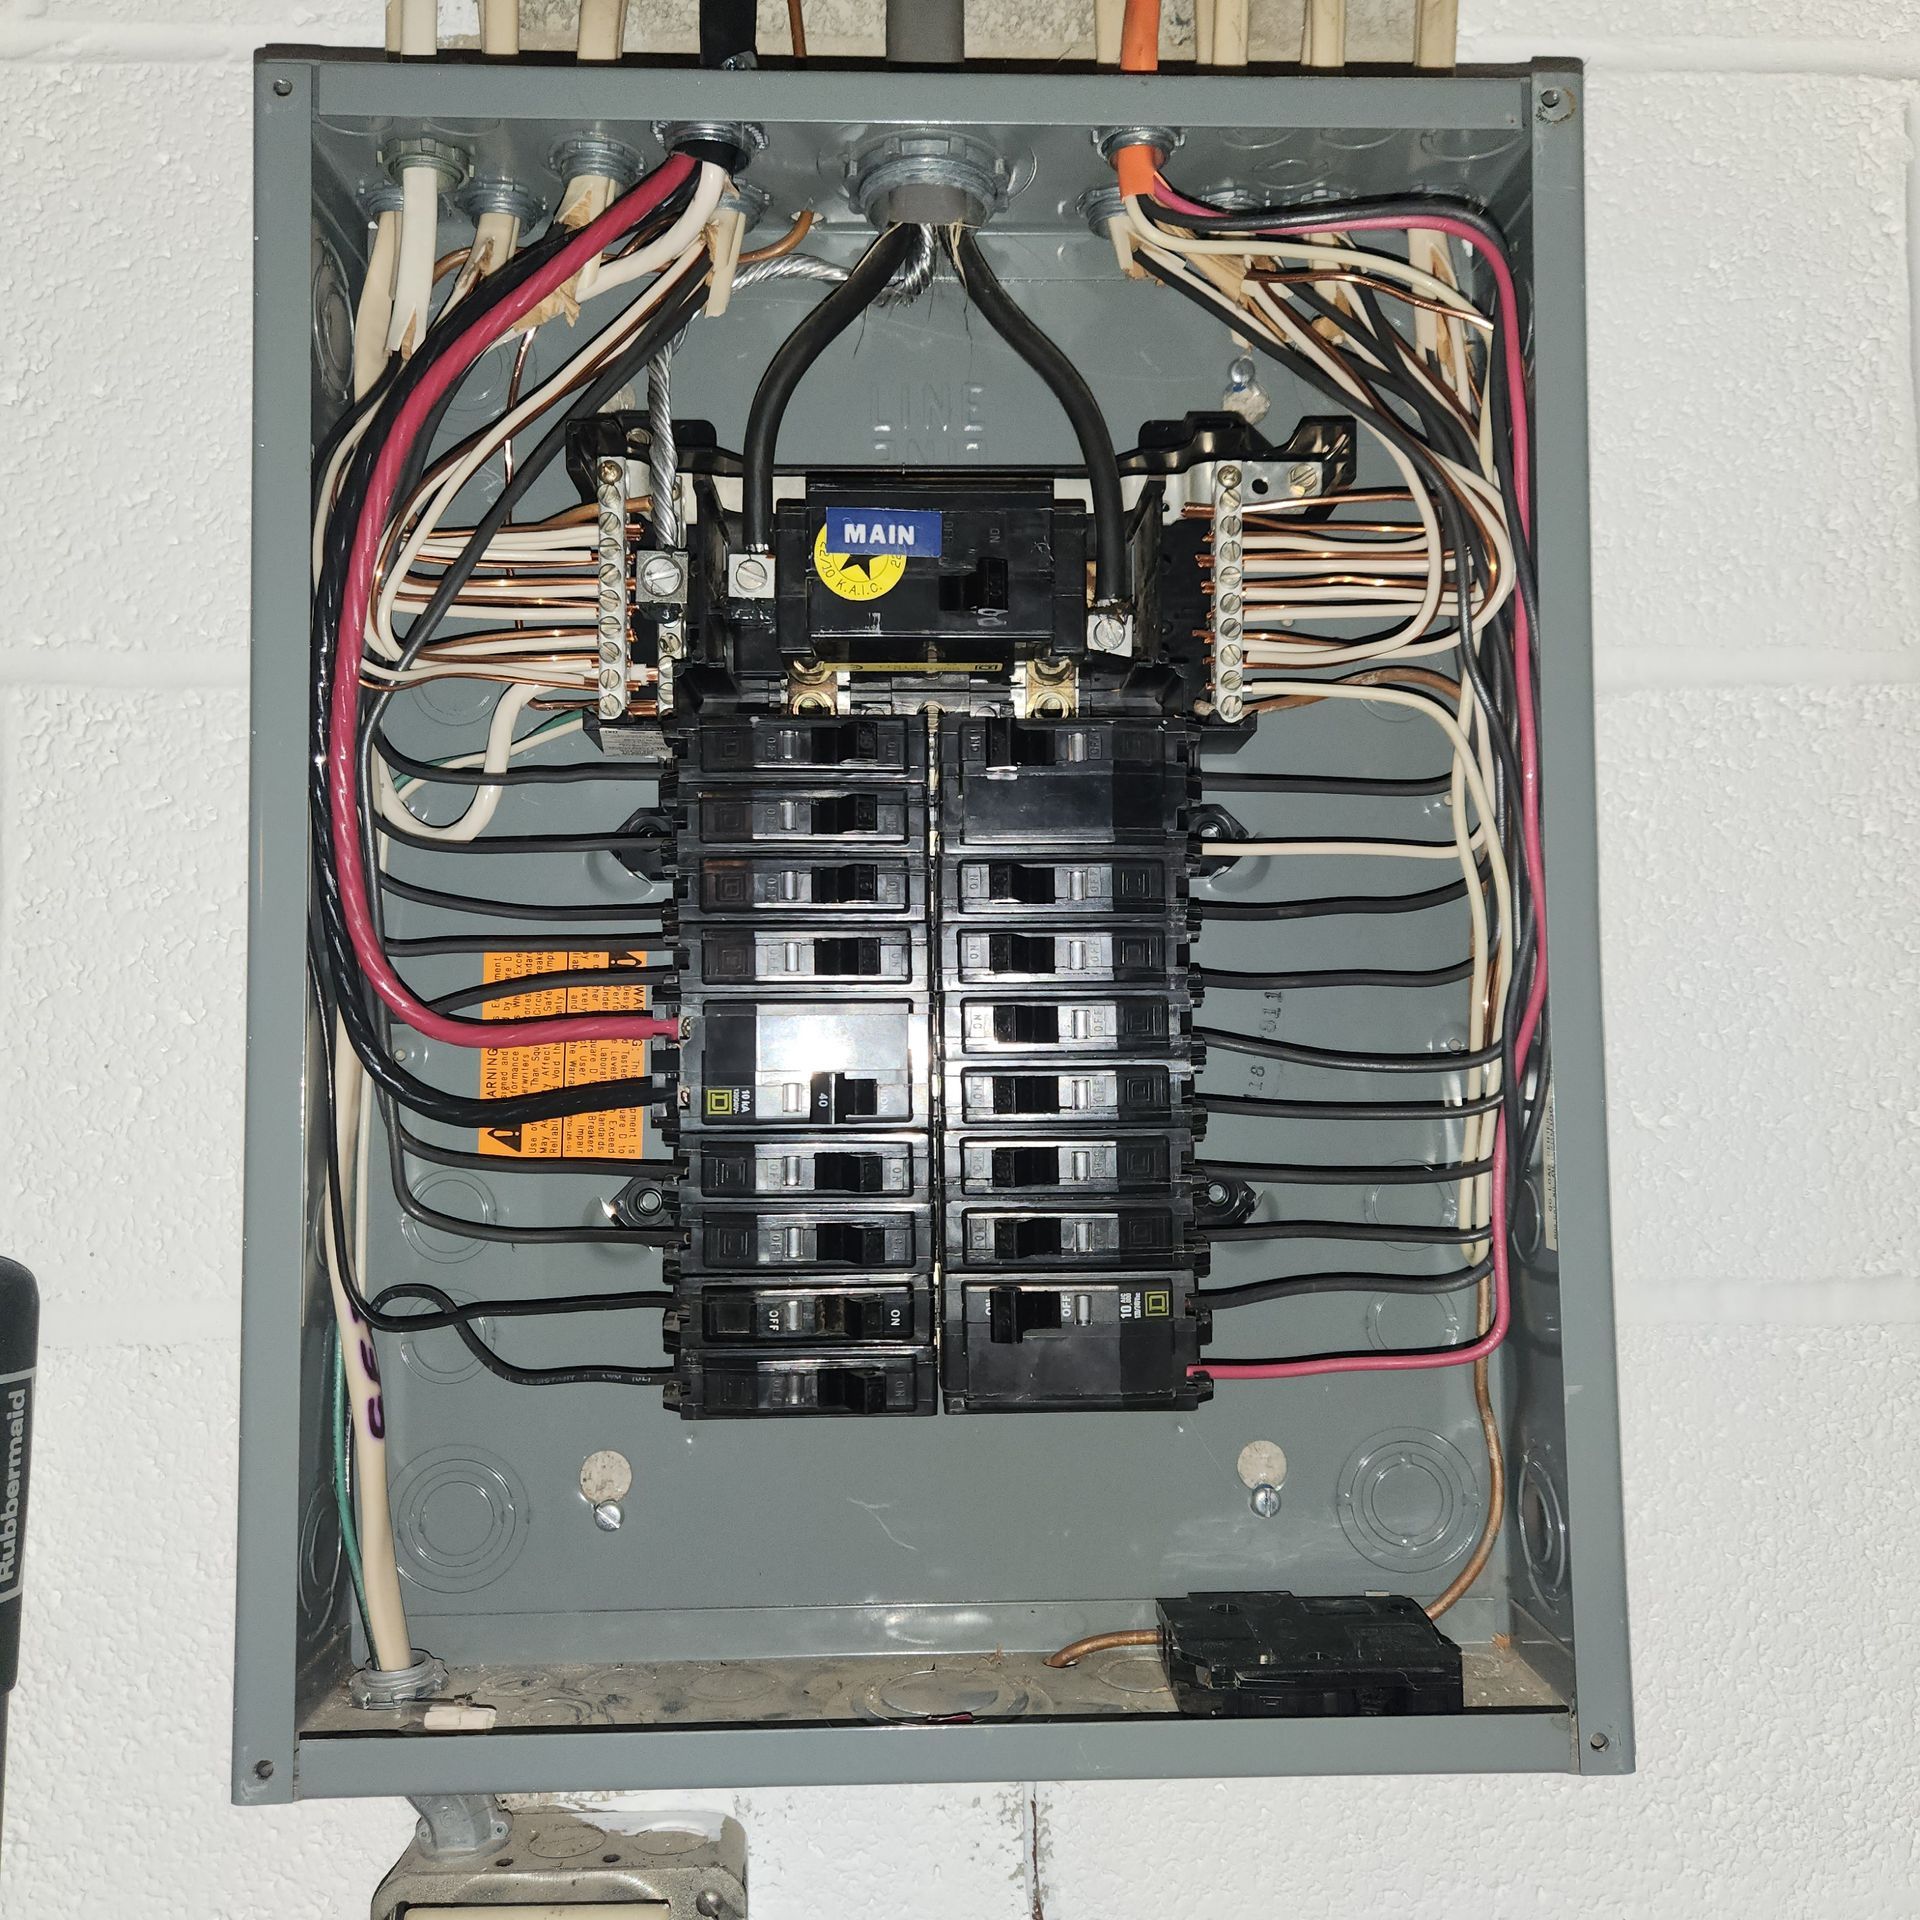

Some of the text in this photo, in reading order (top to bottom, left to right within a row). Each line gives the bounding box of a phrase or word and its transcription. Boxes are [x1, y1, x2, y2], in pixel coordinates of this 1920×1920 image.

[869, 382, 986, 432] LINE
[844, 523, 915, 546] MAIN
[514, 952, 522, 974] Exce
[533, 993, 542, 1016] Circu
[486, 1048, 498, 1098] ARNING
[552, 1060, 560, 1079] Void
[578, 1055, 588, 1076] User
[530, 1068, 540, 1086] Than
[741, 1090, 750, 1100] 10
[818, 1092, 829, 1108] 40
[588, 1116, 596, 1152] Breakers
[608, 1120, 618, 1154] Exceed
[528, 1138, 538, 1154] Use
[540, 1136, 550, 1154] May
[1062, 1295, 1072, 1317] OFF
[768, 1310, 780, 1331] OFF
[890, 1310, 900, 1326] ON
[0, 1389, 26, 1582] Rubbermaid
